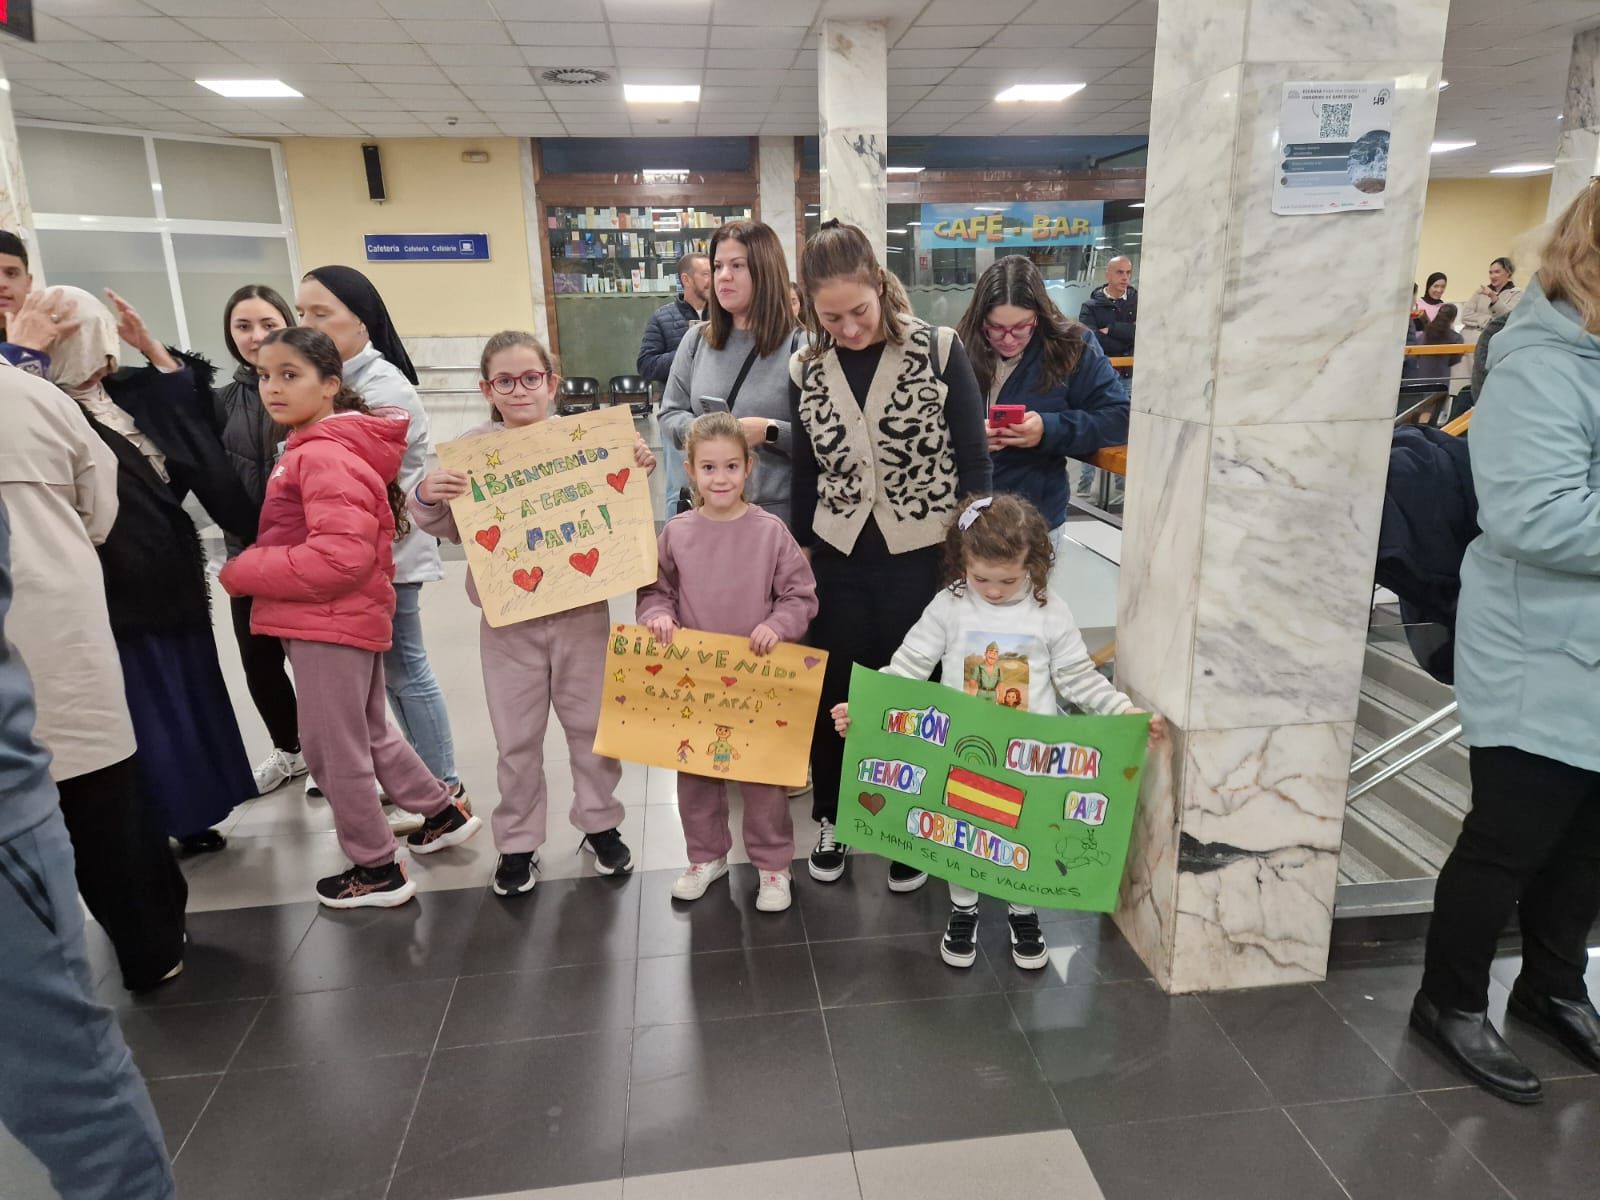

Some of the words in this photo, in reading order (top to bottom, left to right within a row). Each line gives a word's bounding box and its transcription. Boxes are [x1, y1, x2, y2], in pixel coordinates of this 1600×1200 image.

[1032, 214, 1090, 241] BAR
[521, 499, 537, 518] A
[540, 481, 594, 511] CASA
[645, 685, 697, 702] CASA
[887, 706, 949, 745] MISIÓN
[859, 760, 922, 790] HEMOS
[1007, 740, 1098, 778] CUMPLIDA
[1067, 796, 1106, 822] PAPI
[854, 818, 873, 836] PD
[921, 847, 939, 863] SE
[946, 858, 960, 871] VA
[970, 867, 987, 881] DE
[909, 808, 1028, 869] SOBREVIVIDO
